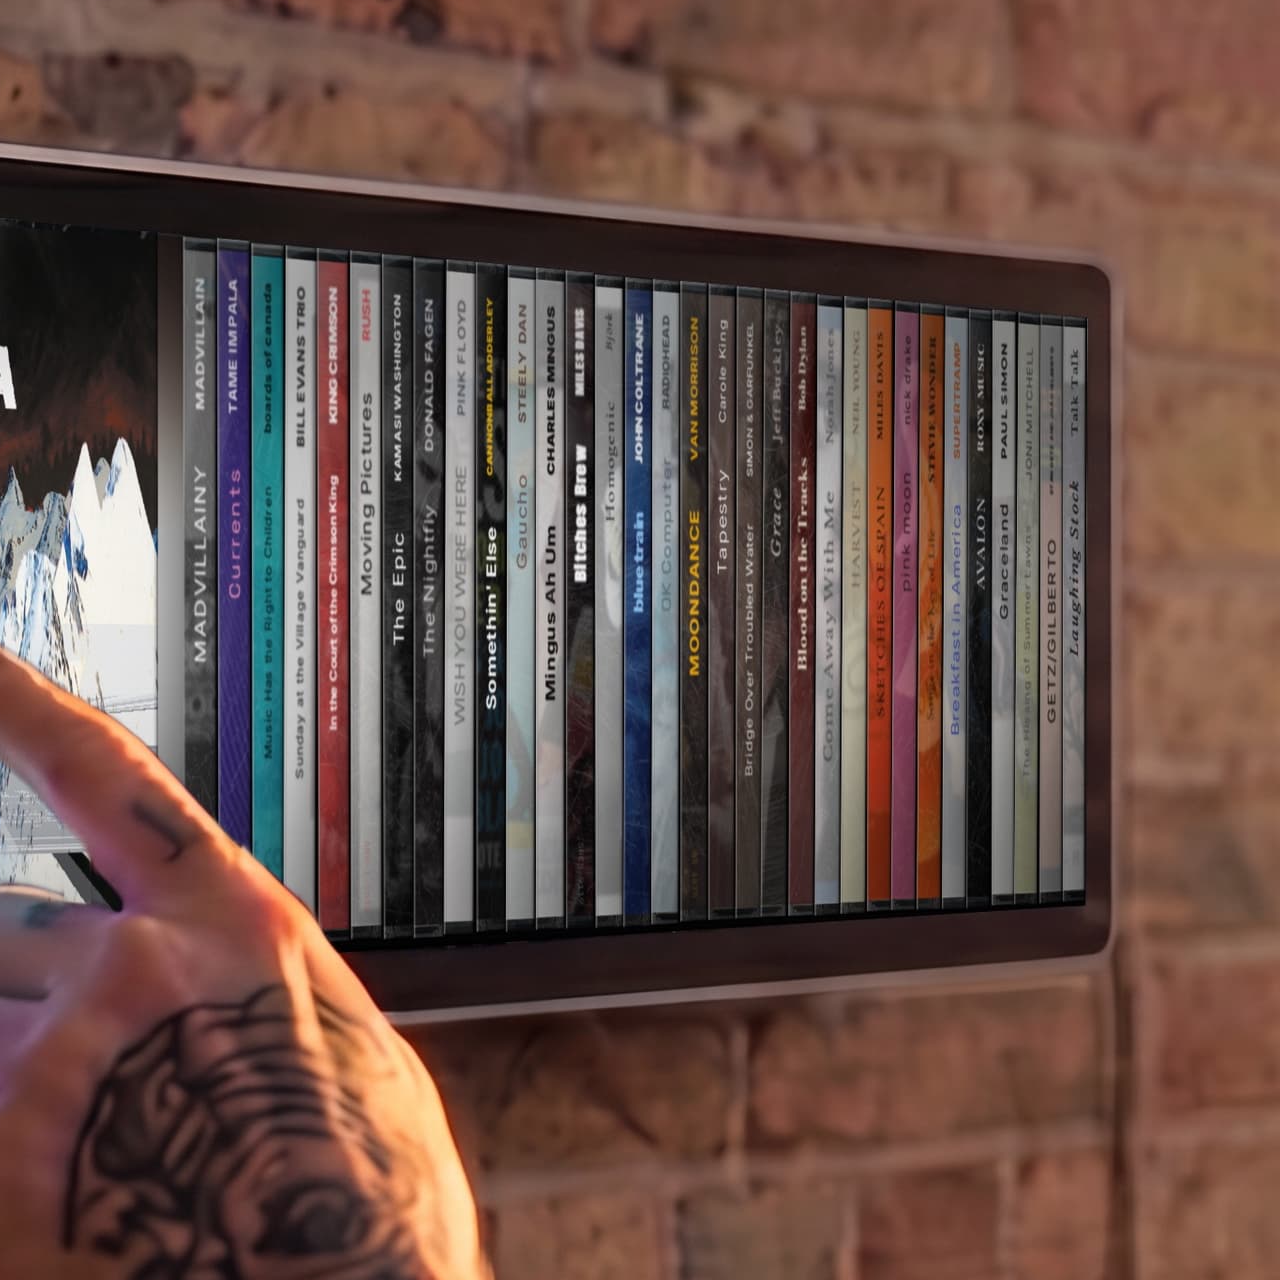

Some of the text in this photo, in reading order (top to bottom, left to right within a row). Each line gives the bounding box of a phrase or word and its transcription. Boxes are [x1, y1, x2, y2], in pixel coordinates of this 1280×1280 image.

[195, 278, 205, 411] MADVILLAIN
[229, 279, 238, 413] TAME IMPALA
[263, 283, 273, 433] boards of canada
[296, 287, 306, 447] BILL EVANS TRIO
[328, 287, 338, 424] KING CRIMSON
[361, 289, 371, 341] RUSH
[424, 299, 434, 451] DONALD FAGEN
[456, 300, 466, 416] PINK FLOYD
[518, 304, 527, 423] STEELY DAN
[575, 308, 585, 396] MILES DAVIS
[661, 315, 670, 409] RADIOHEAD
[718, 319, 729, 423] Carole King
[798, 326, 808, 411] Bob Dylan
[902, 336, 912, 425] nick drake
[393, 294, 402, 481] KAMASI WASHINGTON
[486, 298, 494, 476] CANNONBALL ADDERLEY
[546, 306, 556, 475] CHARLES MINGUS
[635, 313, 644, 464] JOHN COLTRANE
[690, 317, 699, 460] VAN MORRISON
[953, 342, 962, 459] SUPERTRAMP
[1000, 343, 1008, 459] PAUL SIMON
[1070, 349, 1079, 436] Talk Talk
[194, 466, 206, 662] MADVILLAINY
[229, 469, 241, 599] Currents
[360, 393, 374, 595] Moving Pictures
[516, 475, 528, 569] Gaucho
[574, 444, 587, 582] Bitches Brew
[634, 512, 645, 613] blue train
[661, 458, 674, 612] OK Computer
[717, 469, 730, 574] Tapestry
[770, 487, 782, 557] Grace
[797, 457, 809, 670] Blood on the Tracks
[901, 472, 913, 592] pink moon
[976, 498, 986, 590] AVALON
[999, 504, 1009, 620] Graceland
[263, 486, 275, 759] Music Has the Right to Children
[295, 498, 307, 779] Sunday at the Village Vanguard
[329, 475, 339, 730] In the Court of the Crimson King
[392, 532, 406, 646] The Epic
[423, 505, 437, 657] The Nightfly
[454, 466, 467, 726] WISH YOU WERE HERE
[485, 528, 498, 709] Somethin' Else
[545, 526, 558, 701] Mingus Ah Um
[689, 511, 700, 676] MOONDANCE
[822, 491, 836, 762] Come Away With Me
[950, 505, 962, 735] Breakfast in America
[1046, 539, 1056, 724] GETZ/GILBERTO
[1069, 480, 1081, 656] Laughing Stock
[745, 524, 755, 776] Bridge Over Troubled Water
